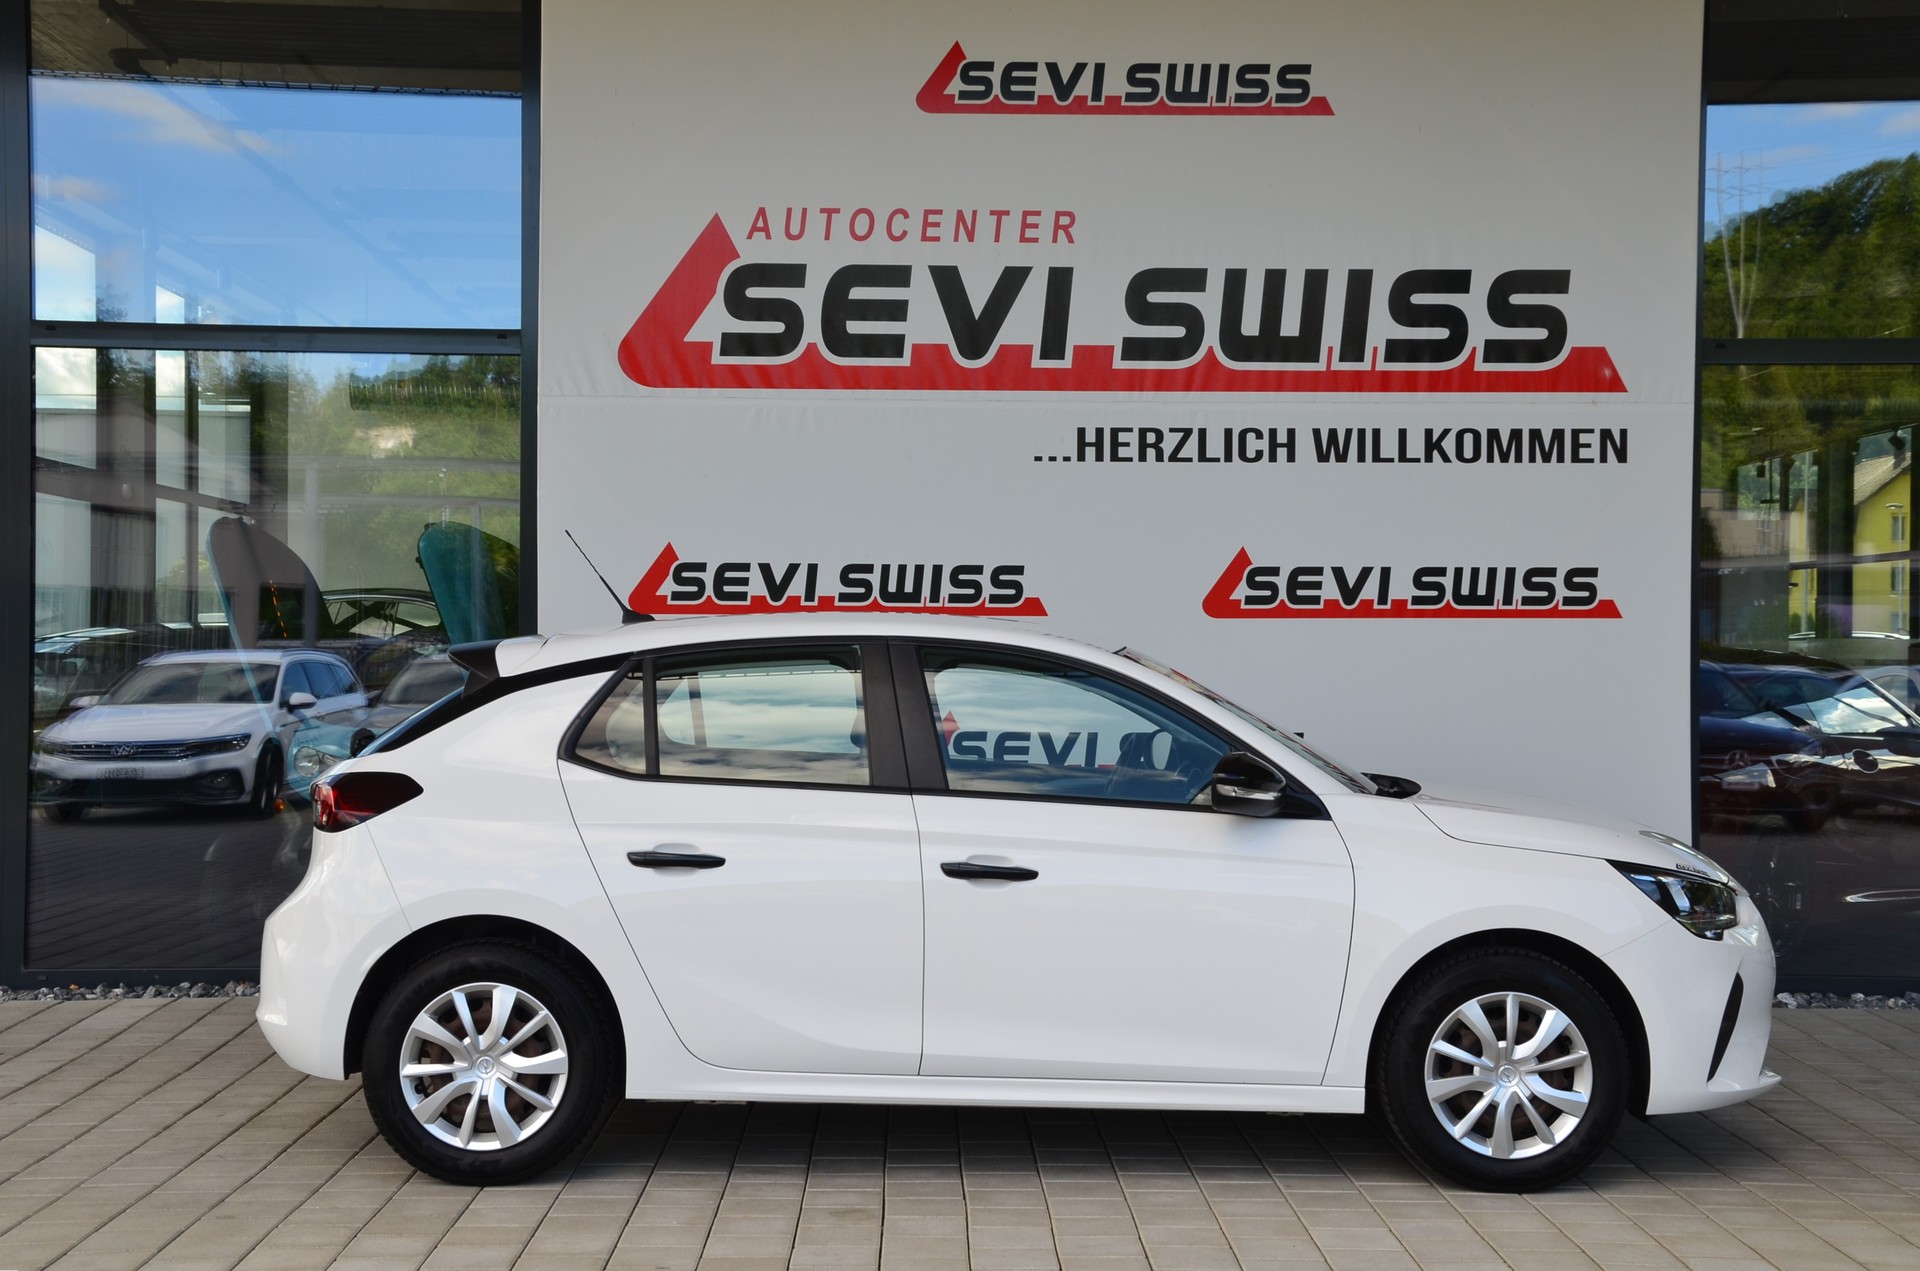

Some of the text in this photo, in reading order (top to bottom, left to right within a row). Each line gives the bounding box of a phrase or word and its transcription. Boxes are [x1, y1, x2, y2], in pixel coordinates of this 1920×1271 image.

[957, 60, 1313, 104] SEVI SWISS
[747, 206, 1077, 244] AUTOCENTER
[719, 262, 1572, 364] SEVI SWISS
[1311, 427, 1628, 464] WILLKOMMEN
[670, 561, 1025, 605] SEVI SWISS
[1244, 566, 1599, 607] SEVI SWISS
[952, 730, 1099, 768] SEVI
